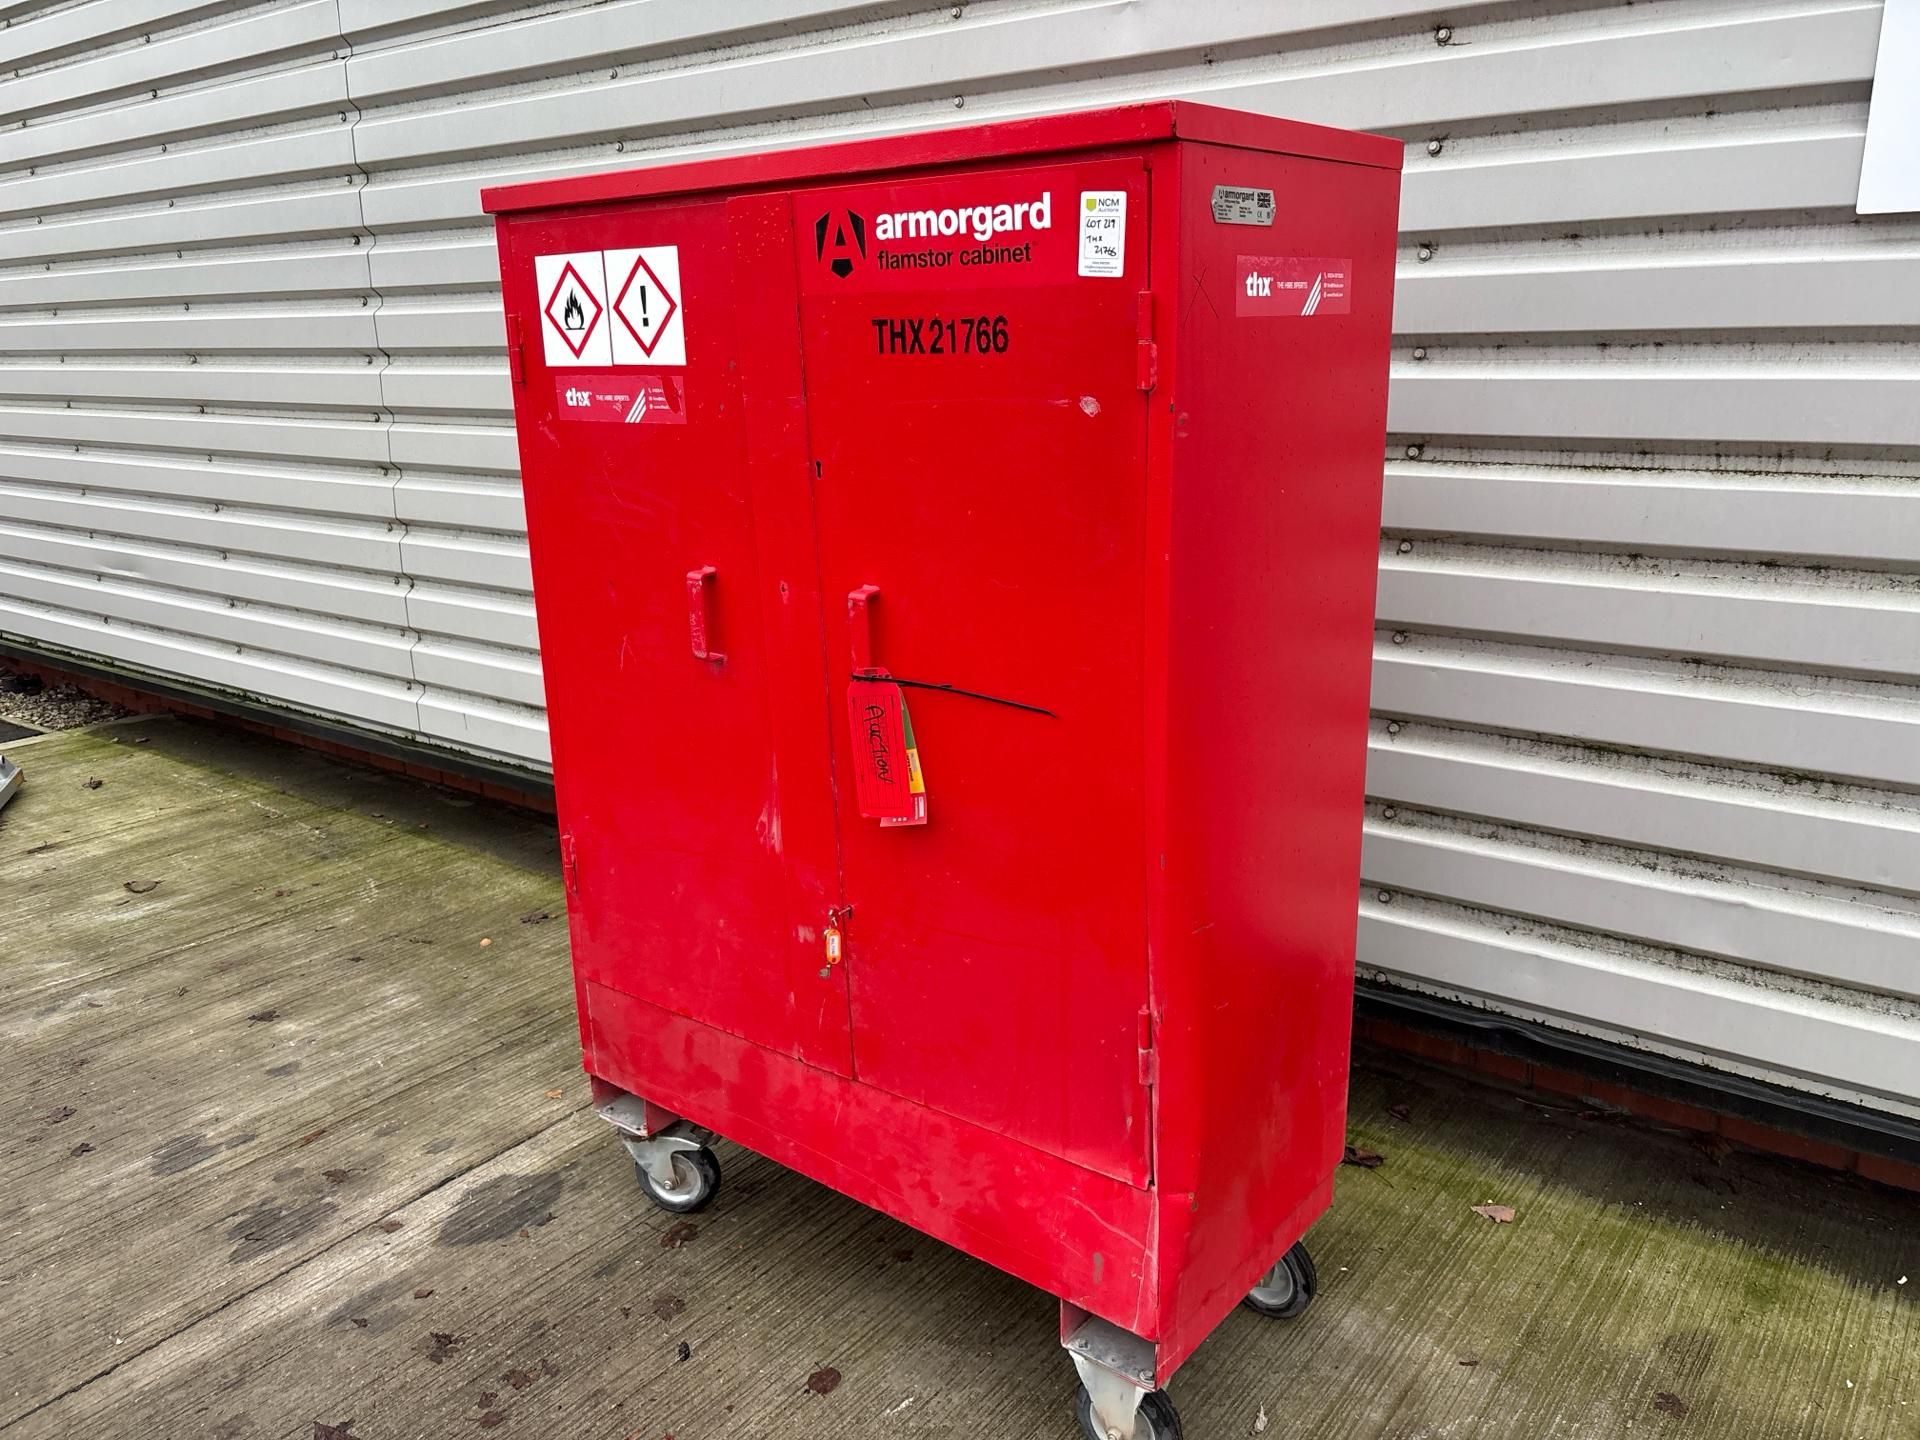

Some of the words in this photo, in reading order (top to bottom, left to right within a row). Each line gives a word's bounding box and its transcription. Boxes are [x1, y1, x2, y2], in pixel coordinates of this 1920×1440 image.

[1098, 198, 1120, 207] NCM
[1224, 189, 1255, 203] armorgard
[875, 191, 1052, 241] armorgard
[1086, 219, 1102, 229] LOT
[1086, 235, 1103, 243] THX
[877, 249, 953, 270] flamstor
[959, 242, 1032, 266] cabinet
[1245, 271, 1271, 297] thx
[871, 315, 1009, 354] THX21766
[565, 387, 591, 407] thx
